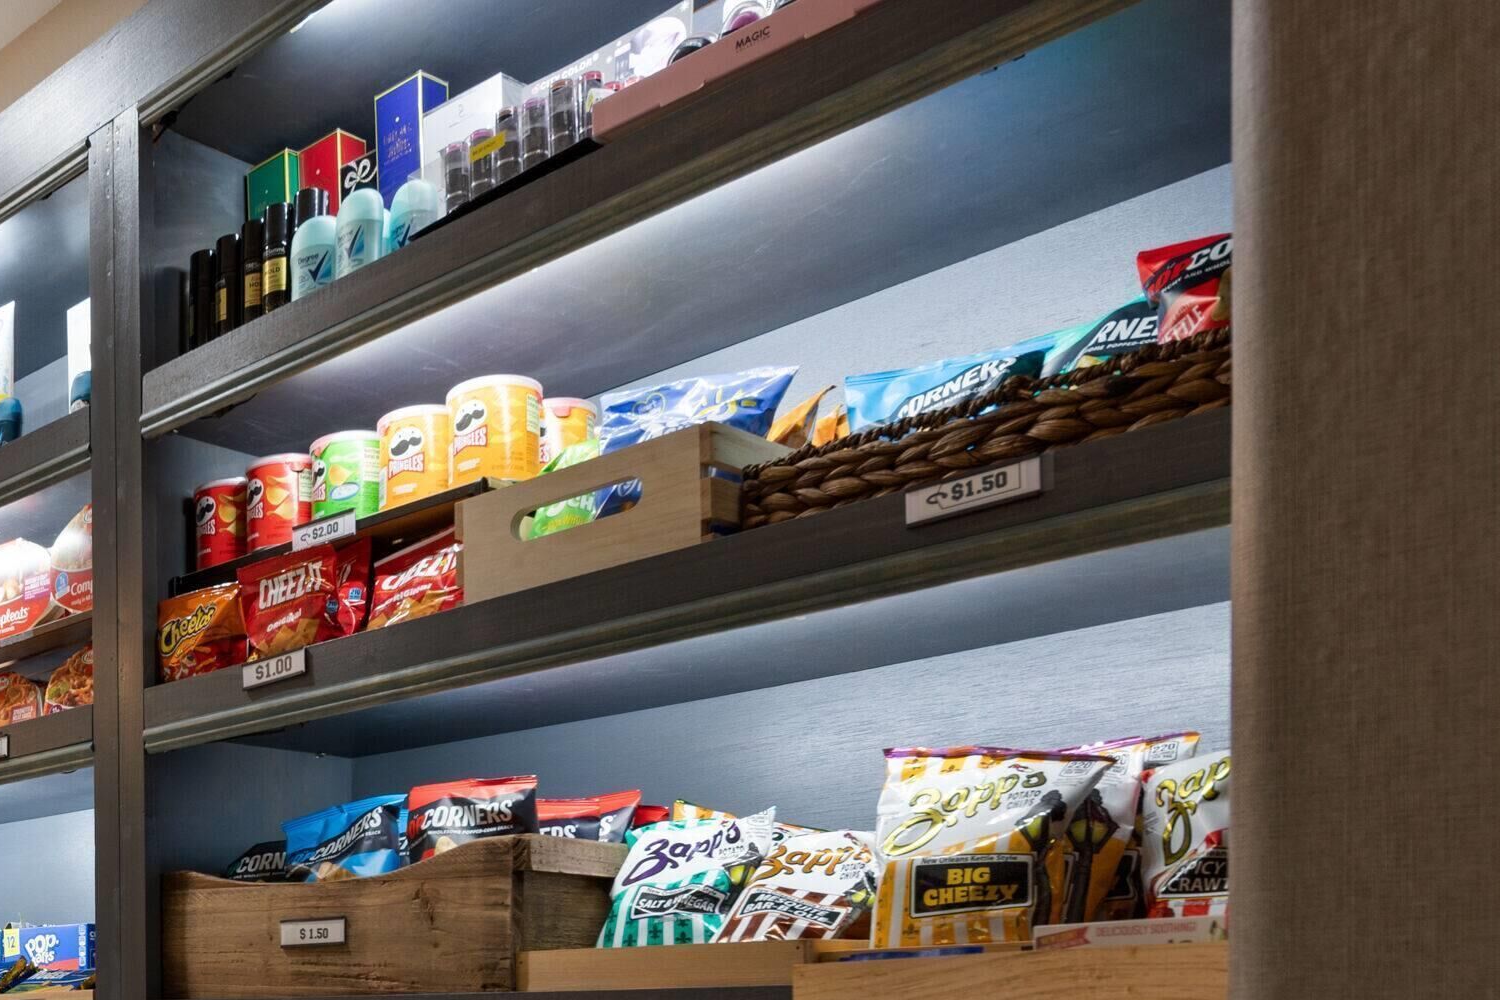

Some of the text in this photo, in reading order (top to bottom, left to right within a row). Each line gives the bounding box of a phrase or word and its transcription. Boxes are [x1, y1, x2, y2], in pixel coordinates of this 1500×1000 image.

[735, 25, 771, 50] MAGIC
[951, 472, 1007, 500] $1.50
[312, 522, 339, 539] $2.00
[161, 604, 217, 655] Cheetos
[256, 657, 292, 680] $1.00
[1007, 789, 1041, 801] POTATO
[947, 866, 991, 884] BIG
[638, 897, 665, 910] SALT
[923, 884, 1018, 907] CHEEZY
[309, 927, 328, 940] 1.50
